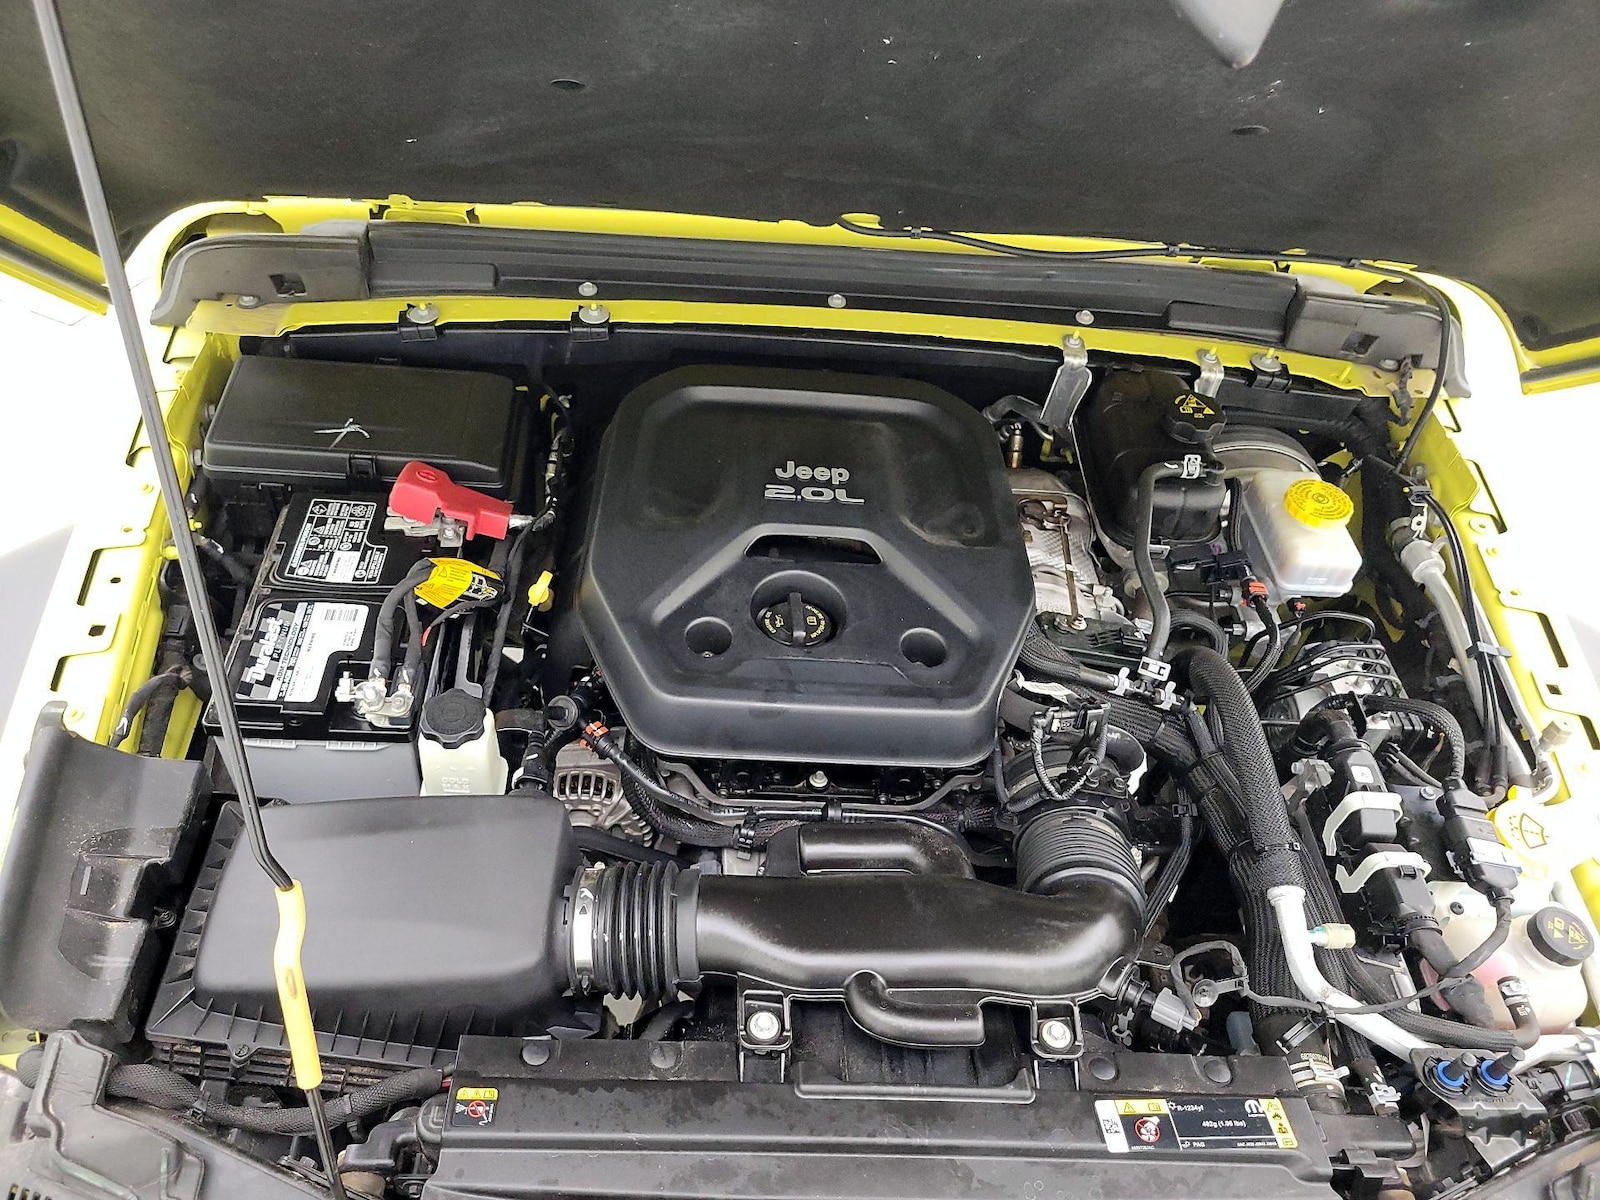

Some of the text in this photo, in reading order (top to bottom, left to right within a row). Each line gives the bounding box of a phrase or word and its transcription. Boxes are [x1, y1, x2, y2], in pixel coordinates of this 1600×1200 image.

[774, 460, 850, 485] Jeep
[764, 483, 865, 505] 2.0L
[246, 616, 284, 682] Duralast
